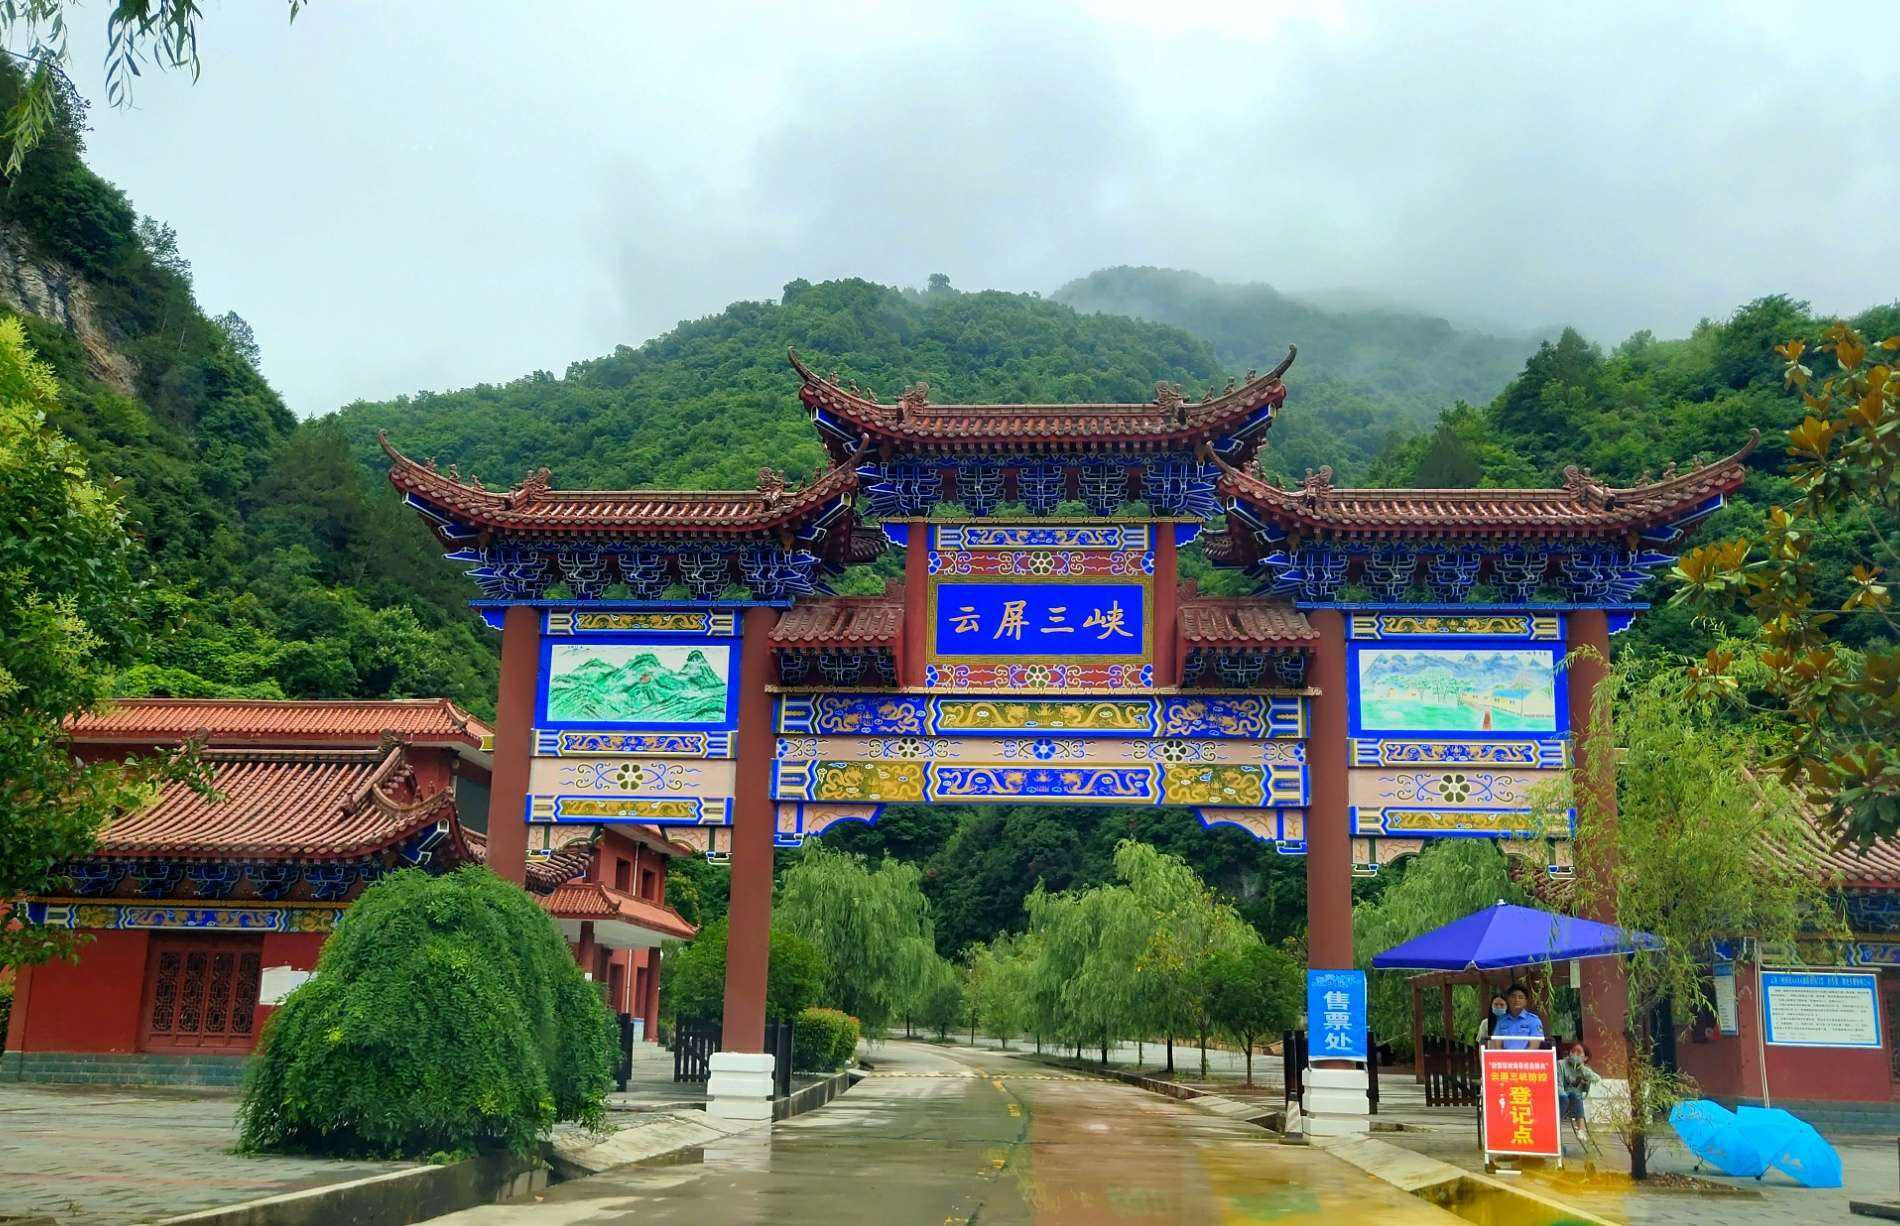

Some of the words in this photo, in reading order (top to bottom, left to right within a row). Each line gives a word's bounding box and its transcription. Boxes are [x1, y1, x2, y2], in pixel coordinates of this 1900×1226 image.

[948, 599, 1134, 640] 云屏三峡
[1323, 990, 1353, 1050] 售票处
[1508, 1086, 1536, 1145] 登记点
